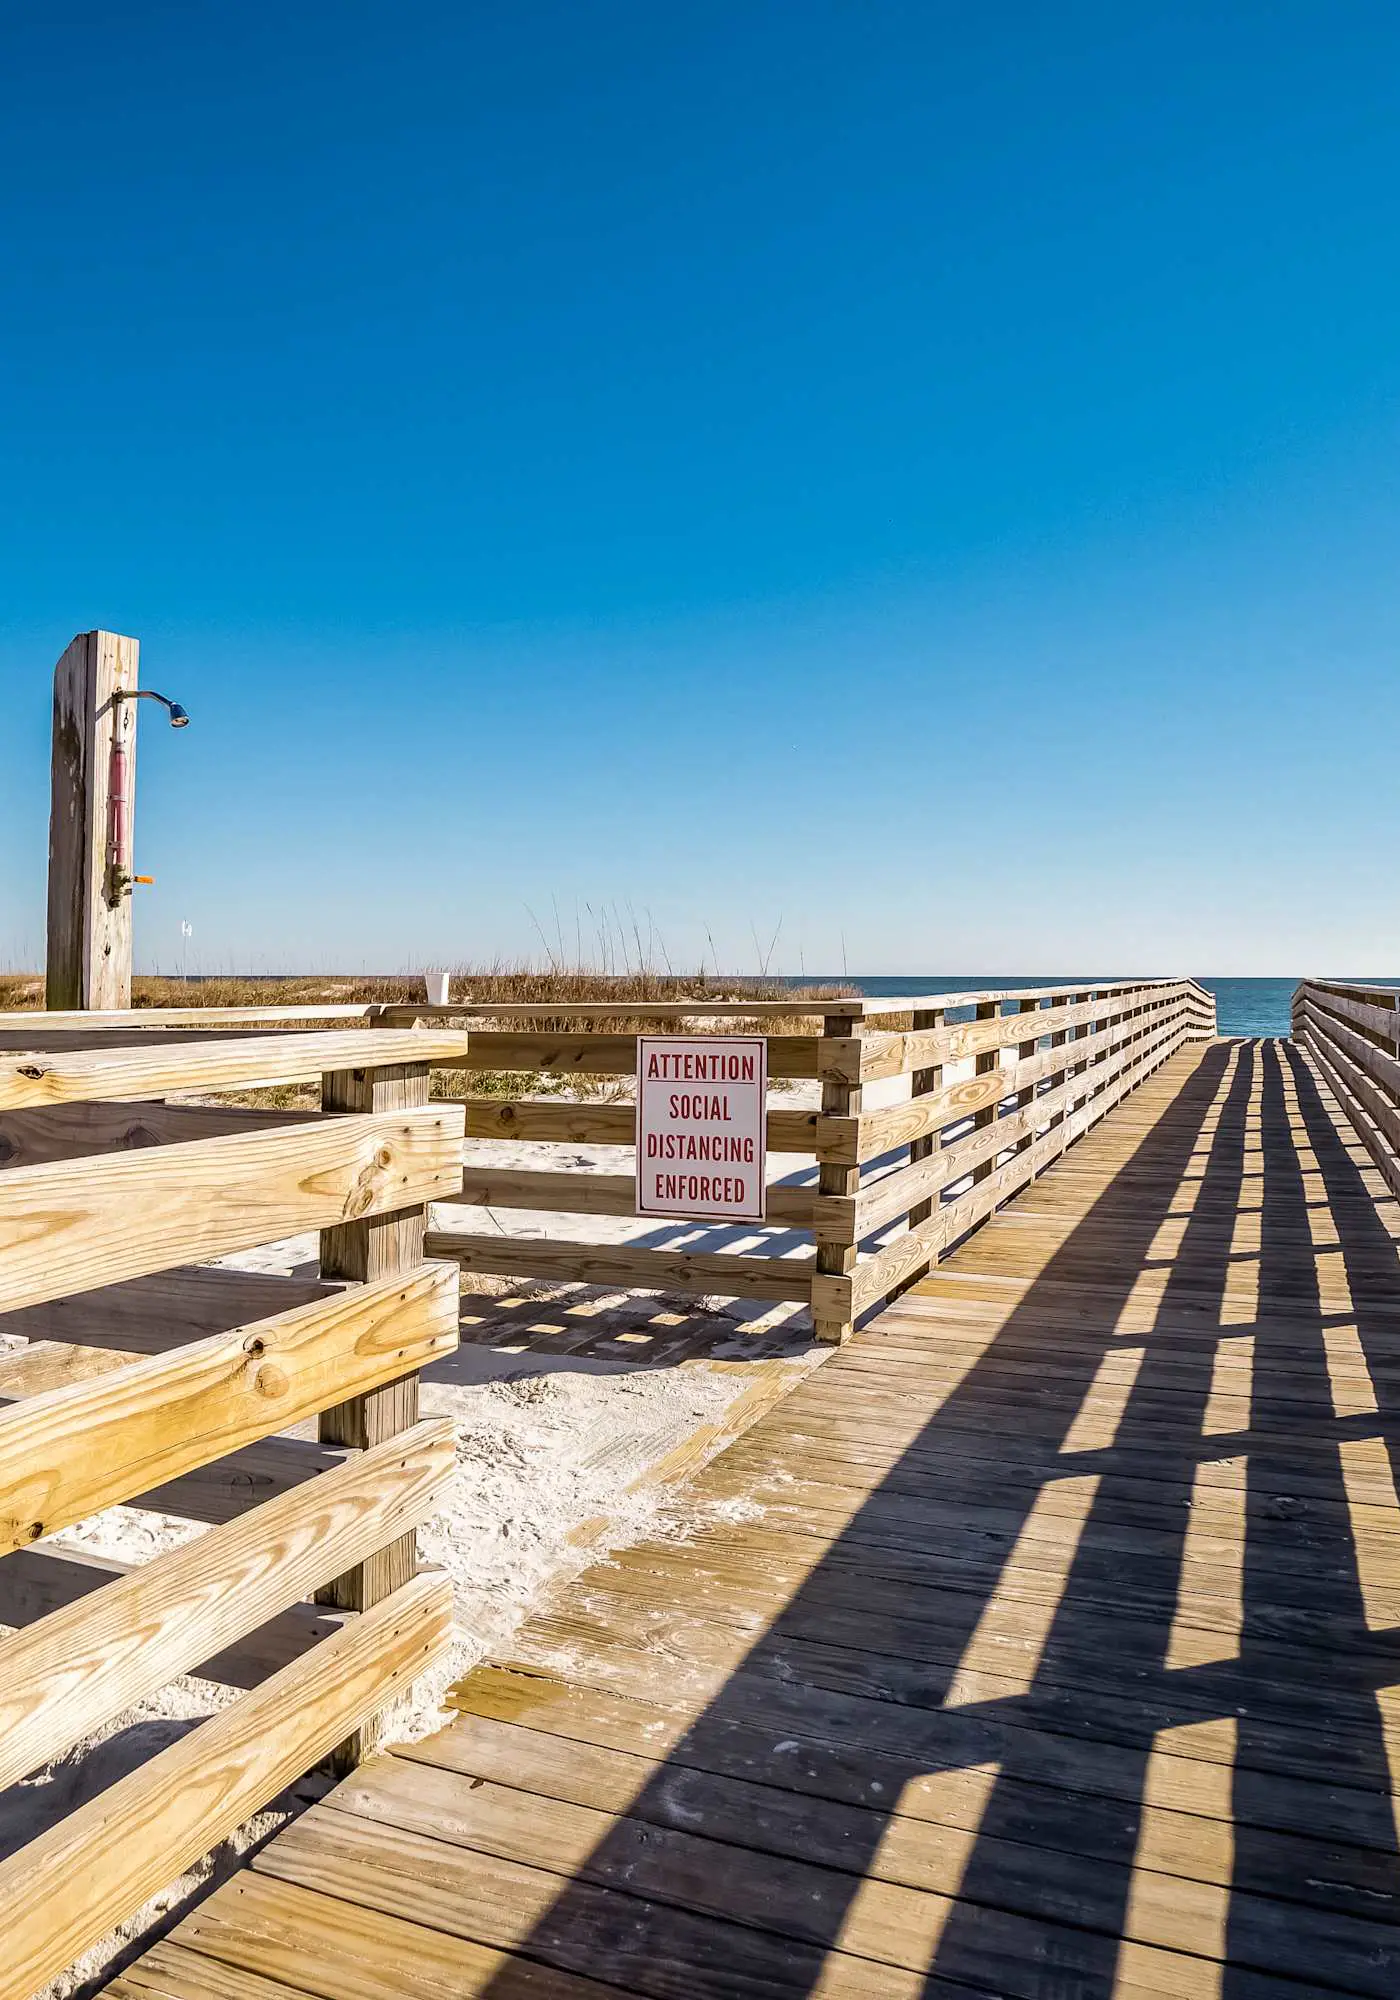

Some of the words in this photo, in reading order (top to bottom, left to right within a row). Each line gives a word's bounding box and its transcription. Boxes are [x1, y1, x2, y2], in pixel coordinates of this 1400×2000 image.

[647, 1053, 753, 1080] ATTENTION
[669, 1094, 731, 1120] SOCIAL
[647, 1133, 753, 1162] DISTANCING
[655, 1174, 744, 1202] ENFORCED
